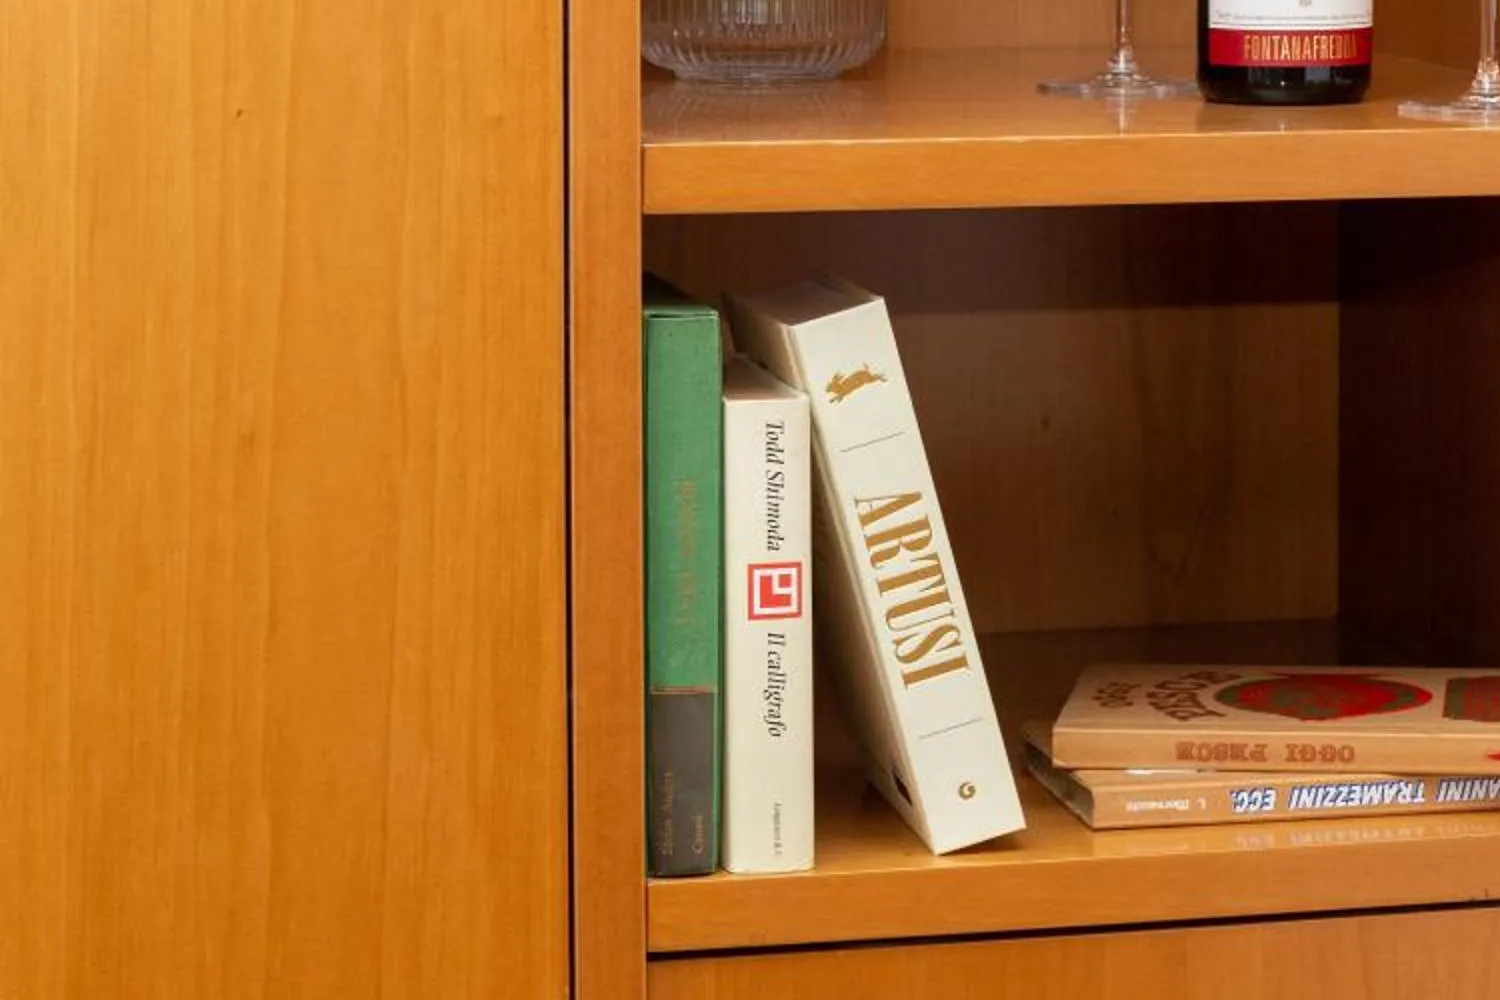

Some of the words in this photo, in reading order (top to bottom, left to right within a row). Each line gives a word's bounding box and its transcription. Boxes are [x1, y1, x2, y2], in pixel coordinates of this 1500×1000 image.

[765, 421, 785, 465] Todd
[766, 469, 785, 551] Shimoda
[854, 491, 971, 690] ARTUSI
[767, 632, 786, 646] Il
[763, 650, 787, 737] calligrafo
[1176, 741, 1268, 762] PESCE
[1284, 743, 1355, 763] OGGI
[1288, 780, 1425, 811] TRAMEZZINI
